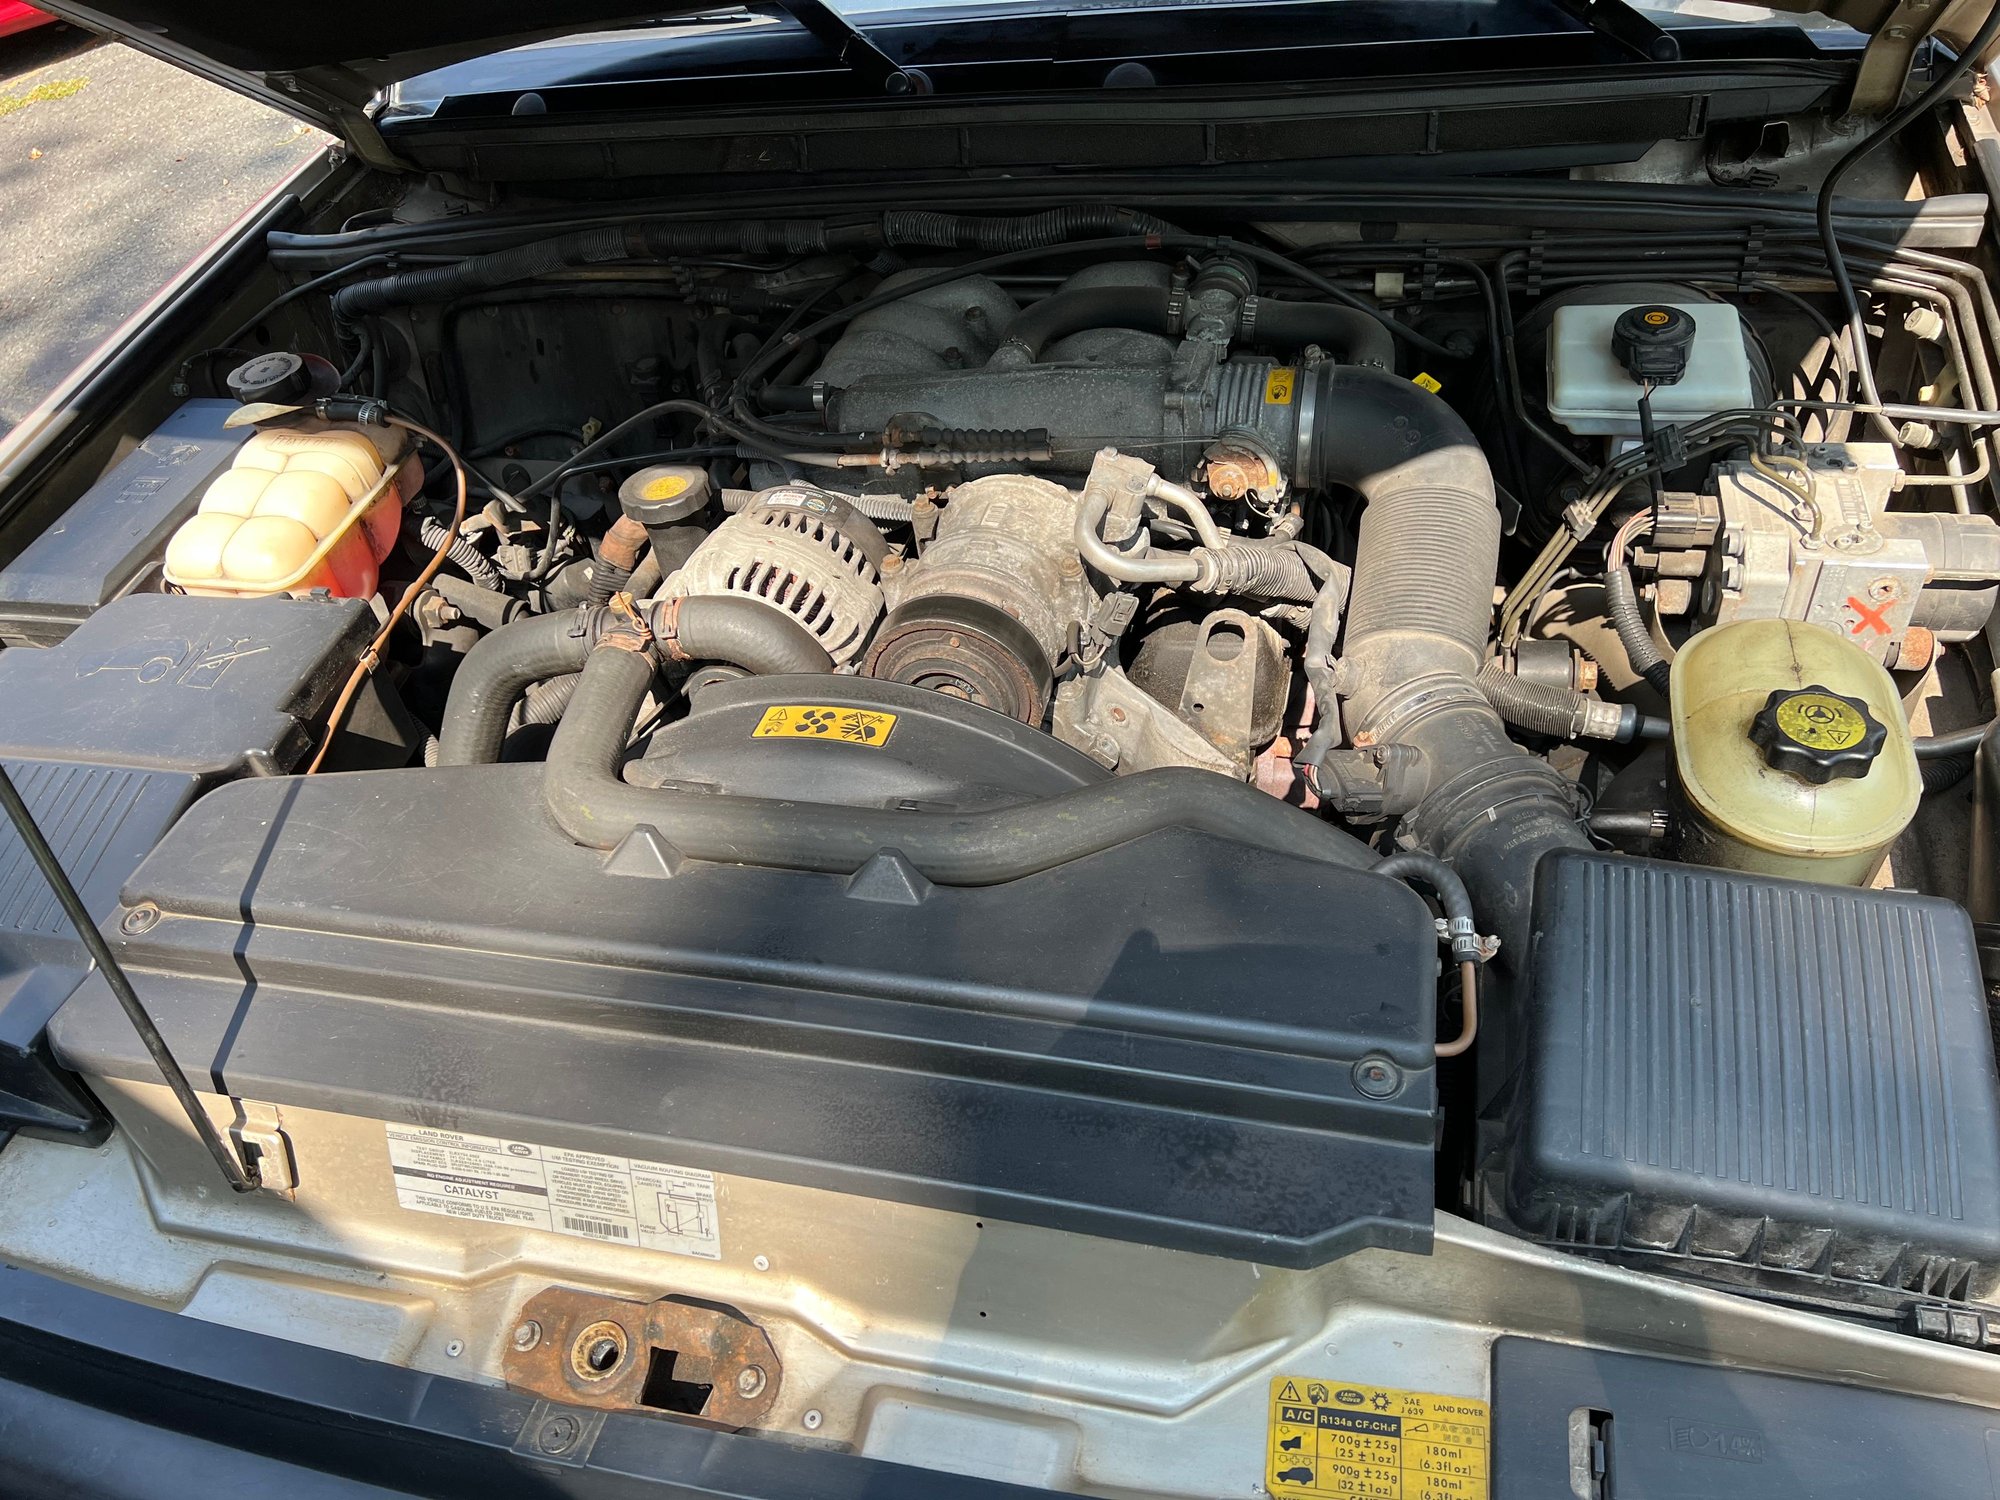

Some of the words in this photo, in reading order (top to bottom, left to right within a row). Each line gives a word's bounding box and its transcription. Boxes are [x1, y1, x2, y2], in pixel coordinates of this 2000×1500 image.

[388, 1132, 409, 1140] VEHICLE
[410, 1136, 435, 1144] EMISSION
[436, 1139, 459, 1147] CONTROL
[440, 1133, 464, 1141] ROVER
[455, 1176, 489, 1186] ADJUSTMENT
[443, 1184, 500, 1201] CATALYST
[1404, 1398, 1421, 1406] SAE
[1285, 1409, 1312, 1421] A/C
[1407, 1408, 1424, 1416] 639
[1433, 1404, 1456, 1414] LAND
[1457, 1406, 1484, 1416] ROVER
[1320, 1415, 1353, 1427] R134a
[1331, 1434, 1361, 1448] 700g
[1376, 1440, 1397, 1453] 25g
[1335, 1447, 1353, 1458] (25
[1426, 1445, 1462, 1459] 180ml
[1332, 1464, 1360, 1480] 900g
[1375, 1470, 1397, 1485] 25g
[1338, 1478, 1355, 1491] (32
[1426, 1476, 1462, 1490] 180ml
